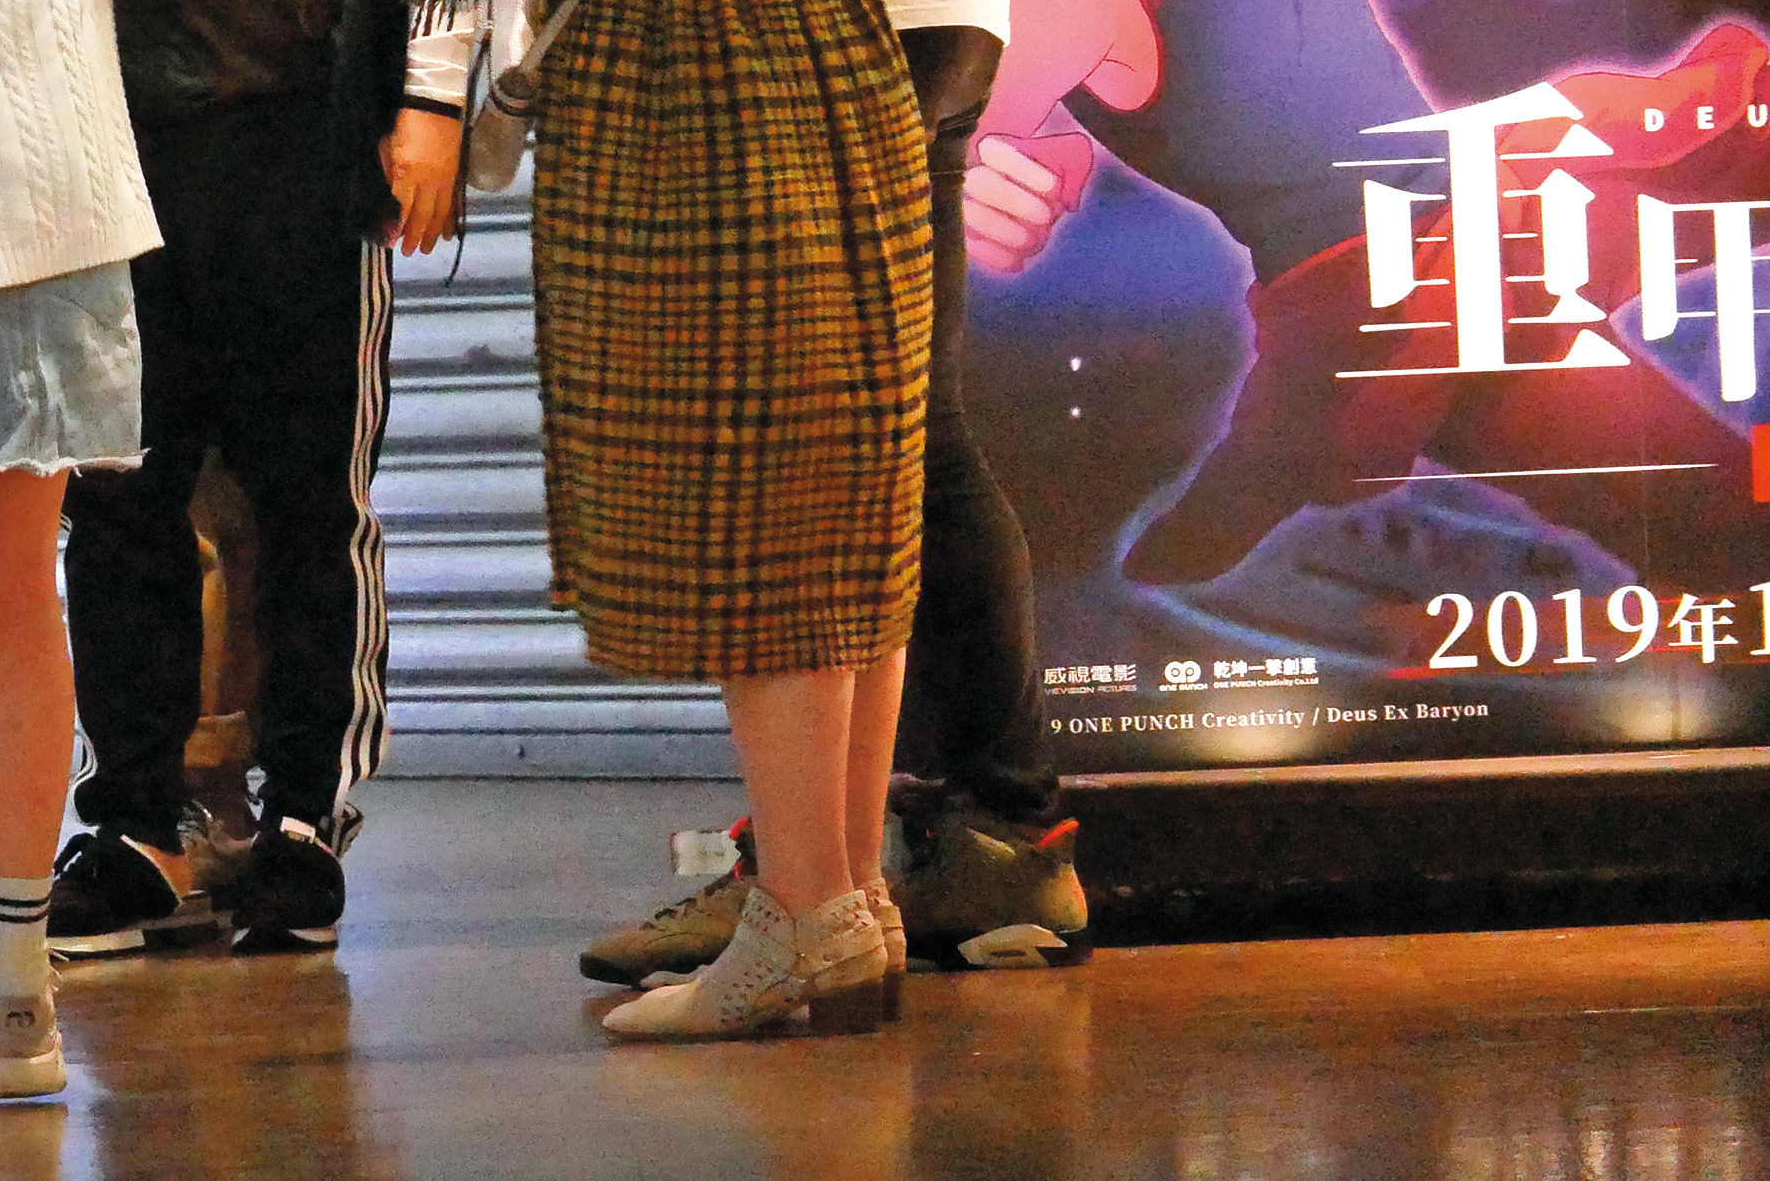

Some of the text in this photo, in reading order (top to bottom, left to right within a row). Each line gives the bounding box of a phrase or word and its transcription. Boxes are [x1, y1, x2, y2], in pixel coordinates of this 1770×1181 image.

[1044, 664, 1137, 685] 威視電影
[1069, 717, 1113, 735] ONE
[1120, 713, 1194, 733] PUNCH
[1202, 708, 1305, 730] Creativity
[1326, 706, 1378, 725] Deus
[1383, 703, 1409, 721] Ex
[1415, 701, 1489, 722] Baryon
